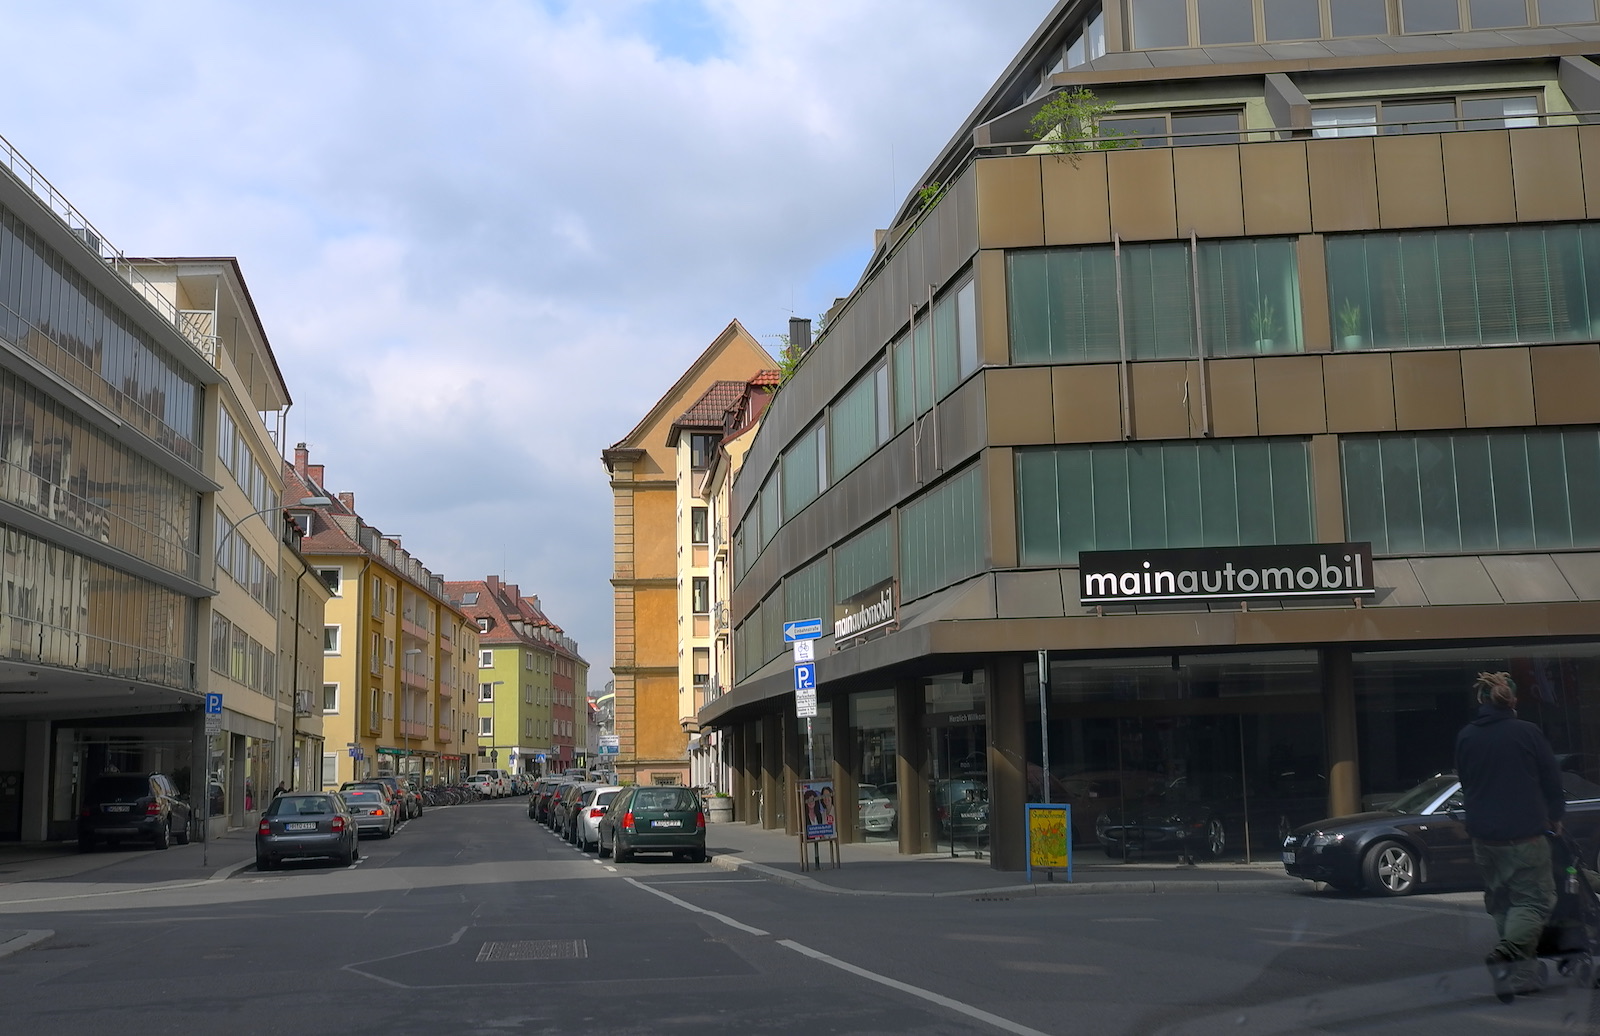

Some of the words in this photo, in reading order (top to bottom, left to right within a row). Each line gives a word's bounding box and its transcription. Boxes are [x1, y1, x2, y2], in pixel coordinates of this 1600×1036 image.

[1084, 553, 1364, 596] mainautomobil
[834, 587, 893, 639] mainautomobil
[798, 667, 809, 689] P
[210, 695, 219, 713] P
